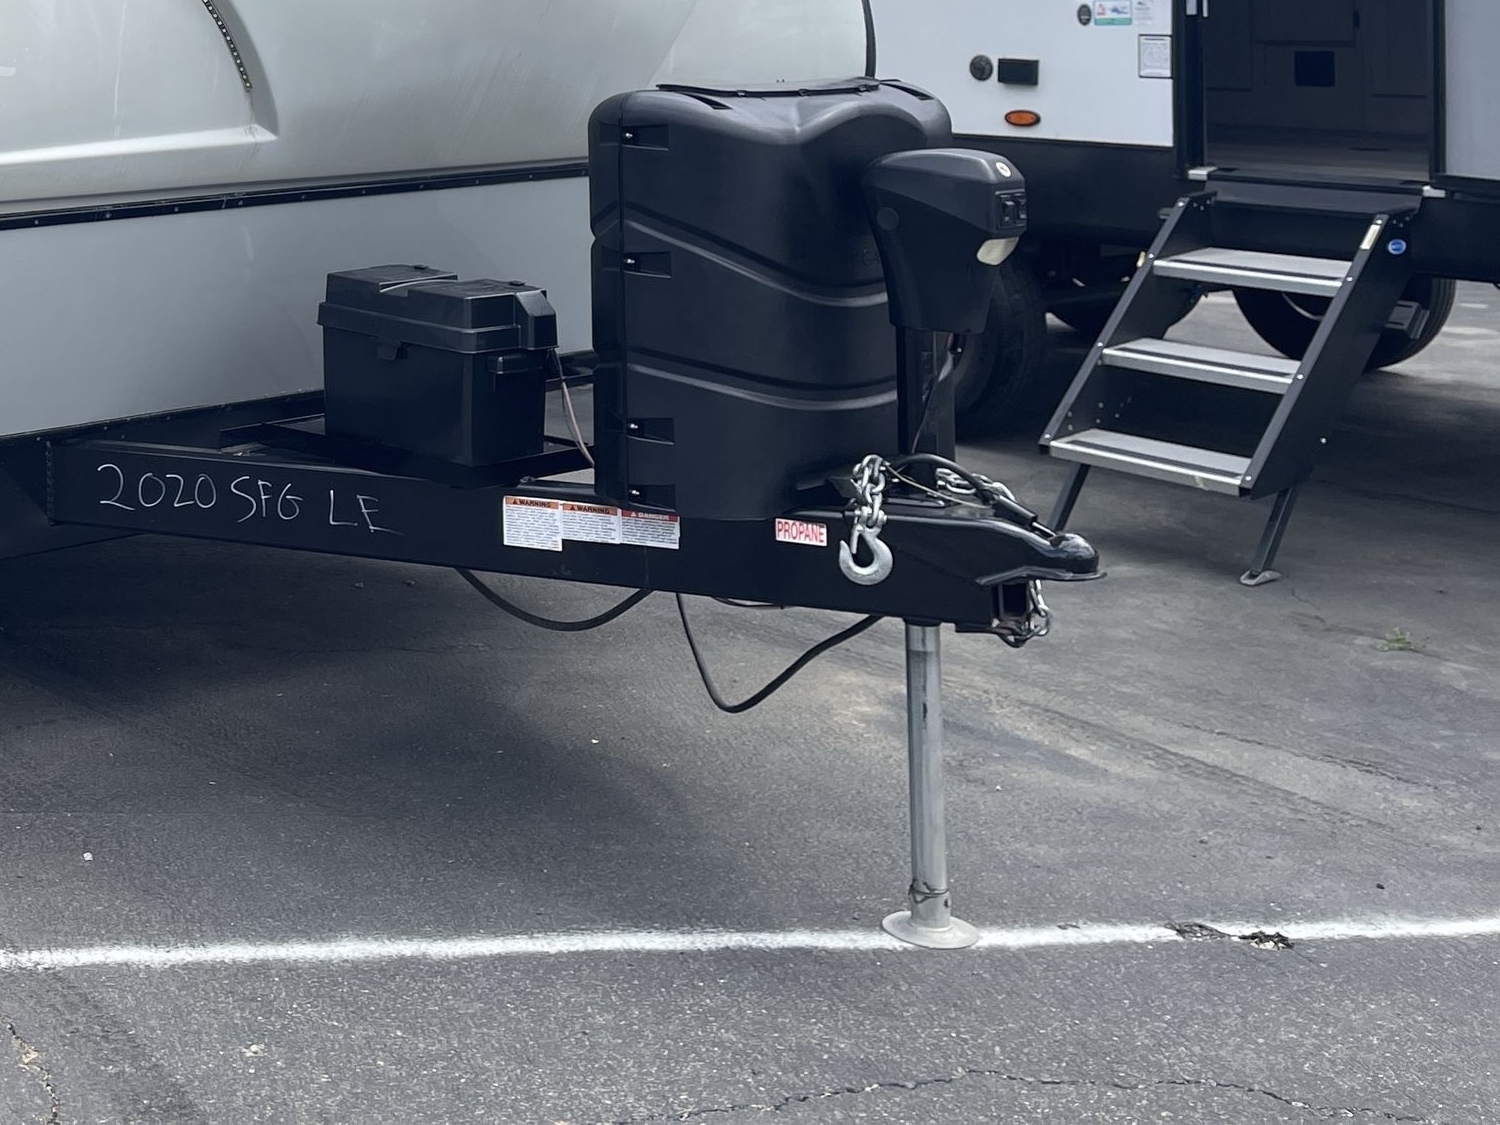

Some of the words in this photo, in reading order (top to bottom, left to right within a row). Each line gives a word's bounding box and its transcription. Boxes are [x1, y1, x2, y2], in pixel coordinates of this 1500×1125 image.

[97, 463, 217, 511] 2020
[230, 475, 304, 523] SFG
[519, 498, 552, 508] WARNING
[576, 504, 610, 515] WARNING
[777, 520, 825, 543] PROPANE
